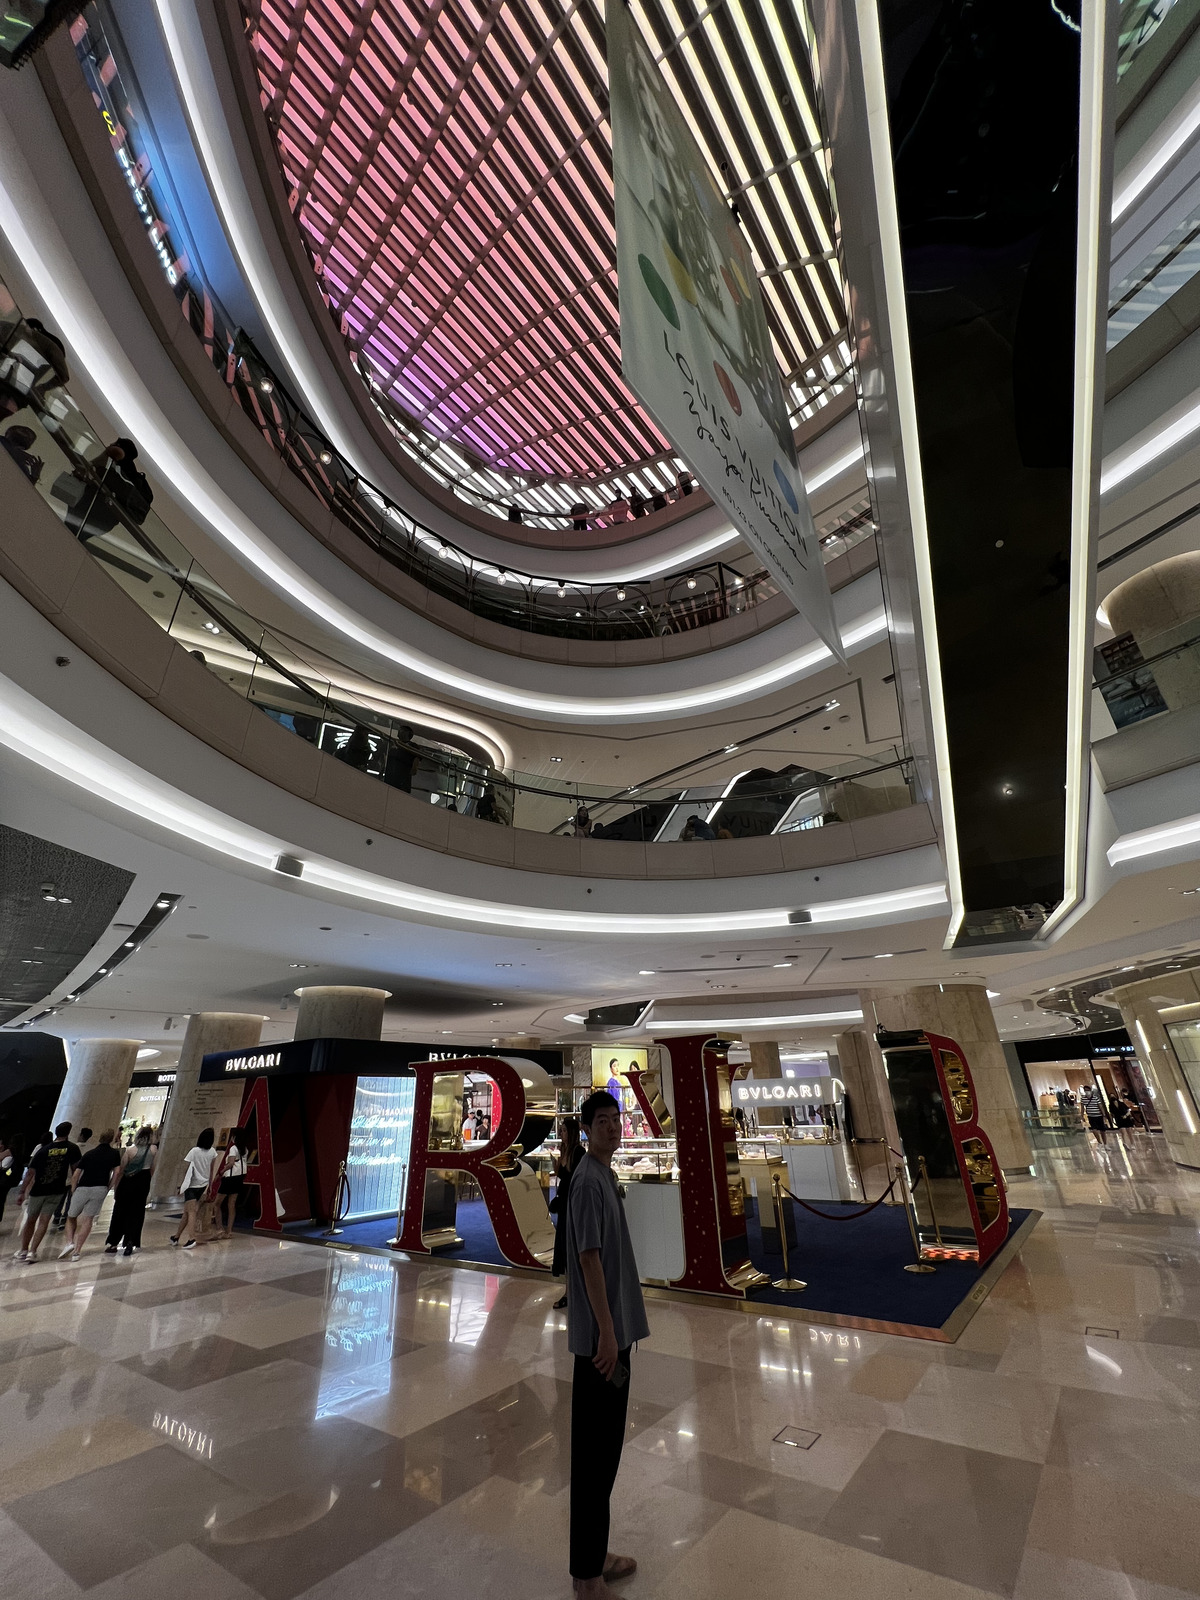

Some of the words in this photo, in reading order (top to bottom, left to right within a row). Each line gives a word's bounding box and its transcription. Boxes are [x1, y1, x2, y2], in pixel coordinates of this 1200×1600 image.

[663, 329, 731, 442] LOUIS
[735, 435, 809, 558] VUITTON
[225, 1052, 282, 1071] BVLGARI
[738, 1083, 821, 1101] BVLGARI
